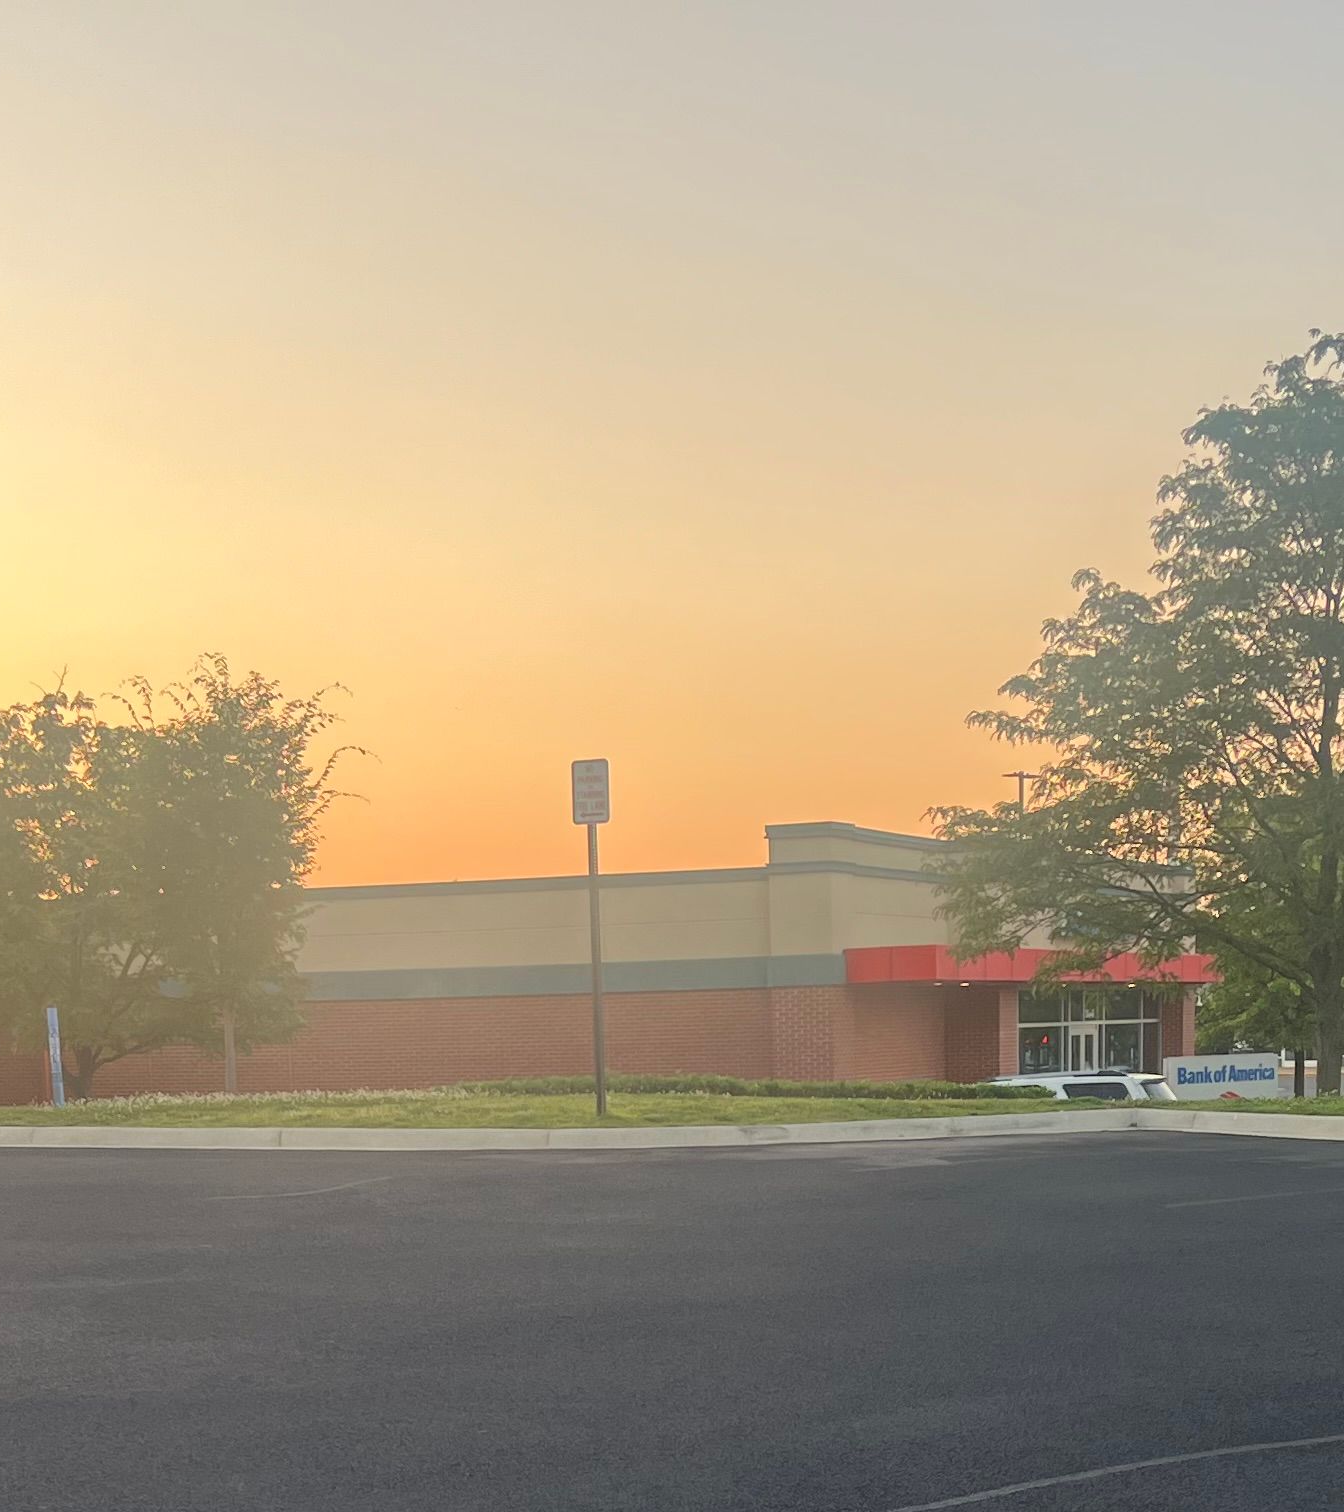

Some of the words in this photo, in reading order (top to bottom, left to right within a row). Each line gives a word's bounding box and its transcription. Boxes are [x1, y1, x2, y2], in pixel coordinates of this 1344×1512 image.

[1177, 1066, 1213, 1085] Bank
[1213, 1065, 1228, 1083] of
[1228, 1063, 1275, 1082] America
